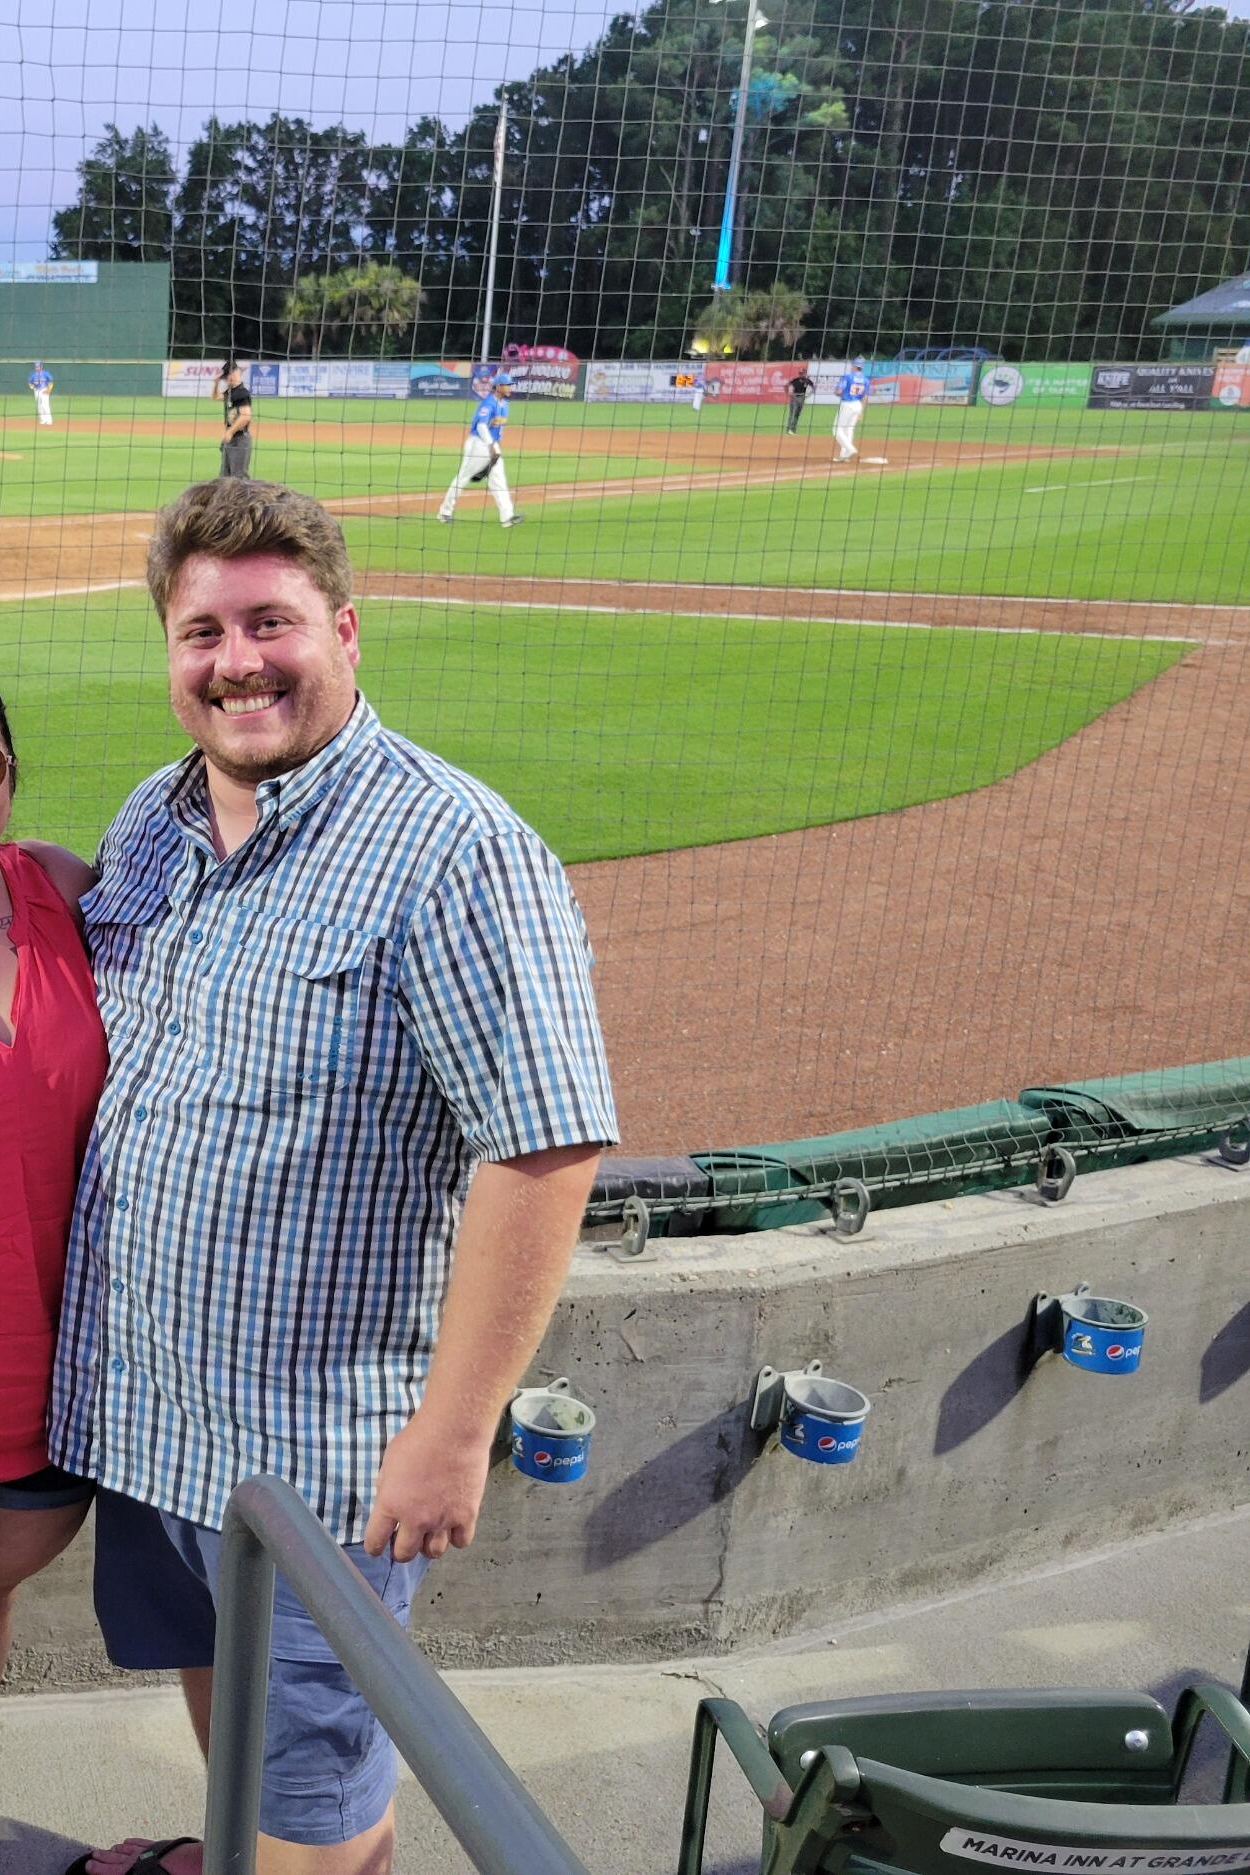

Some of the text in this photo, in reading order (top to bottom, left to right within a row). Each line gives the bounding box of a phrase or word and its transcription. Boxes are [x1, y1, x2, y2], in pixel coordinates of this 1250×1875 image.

[1125, 1344, 1142, 1358] pep
[837, 1436, 861, 1451] pep
[962, 1837, 1058, 1866] MARINA
[1062, 1854, 1108, 1868] INN
[1107, 1855, 1145, 1869] AT
[1147, 1852, 1242, 1869] GRANDE
